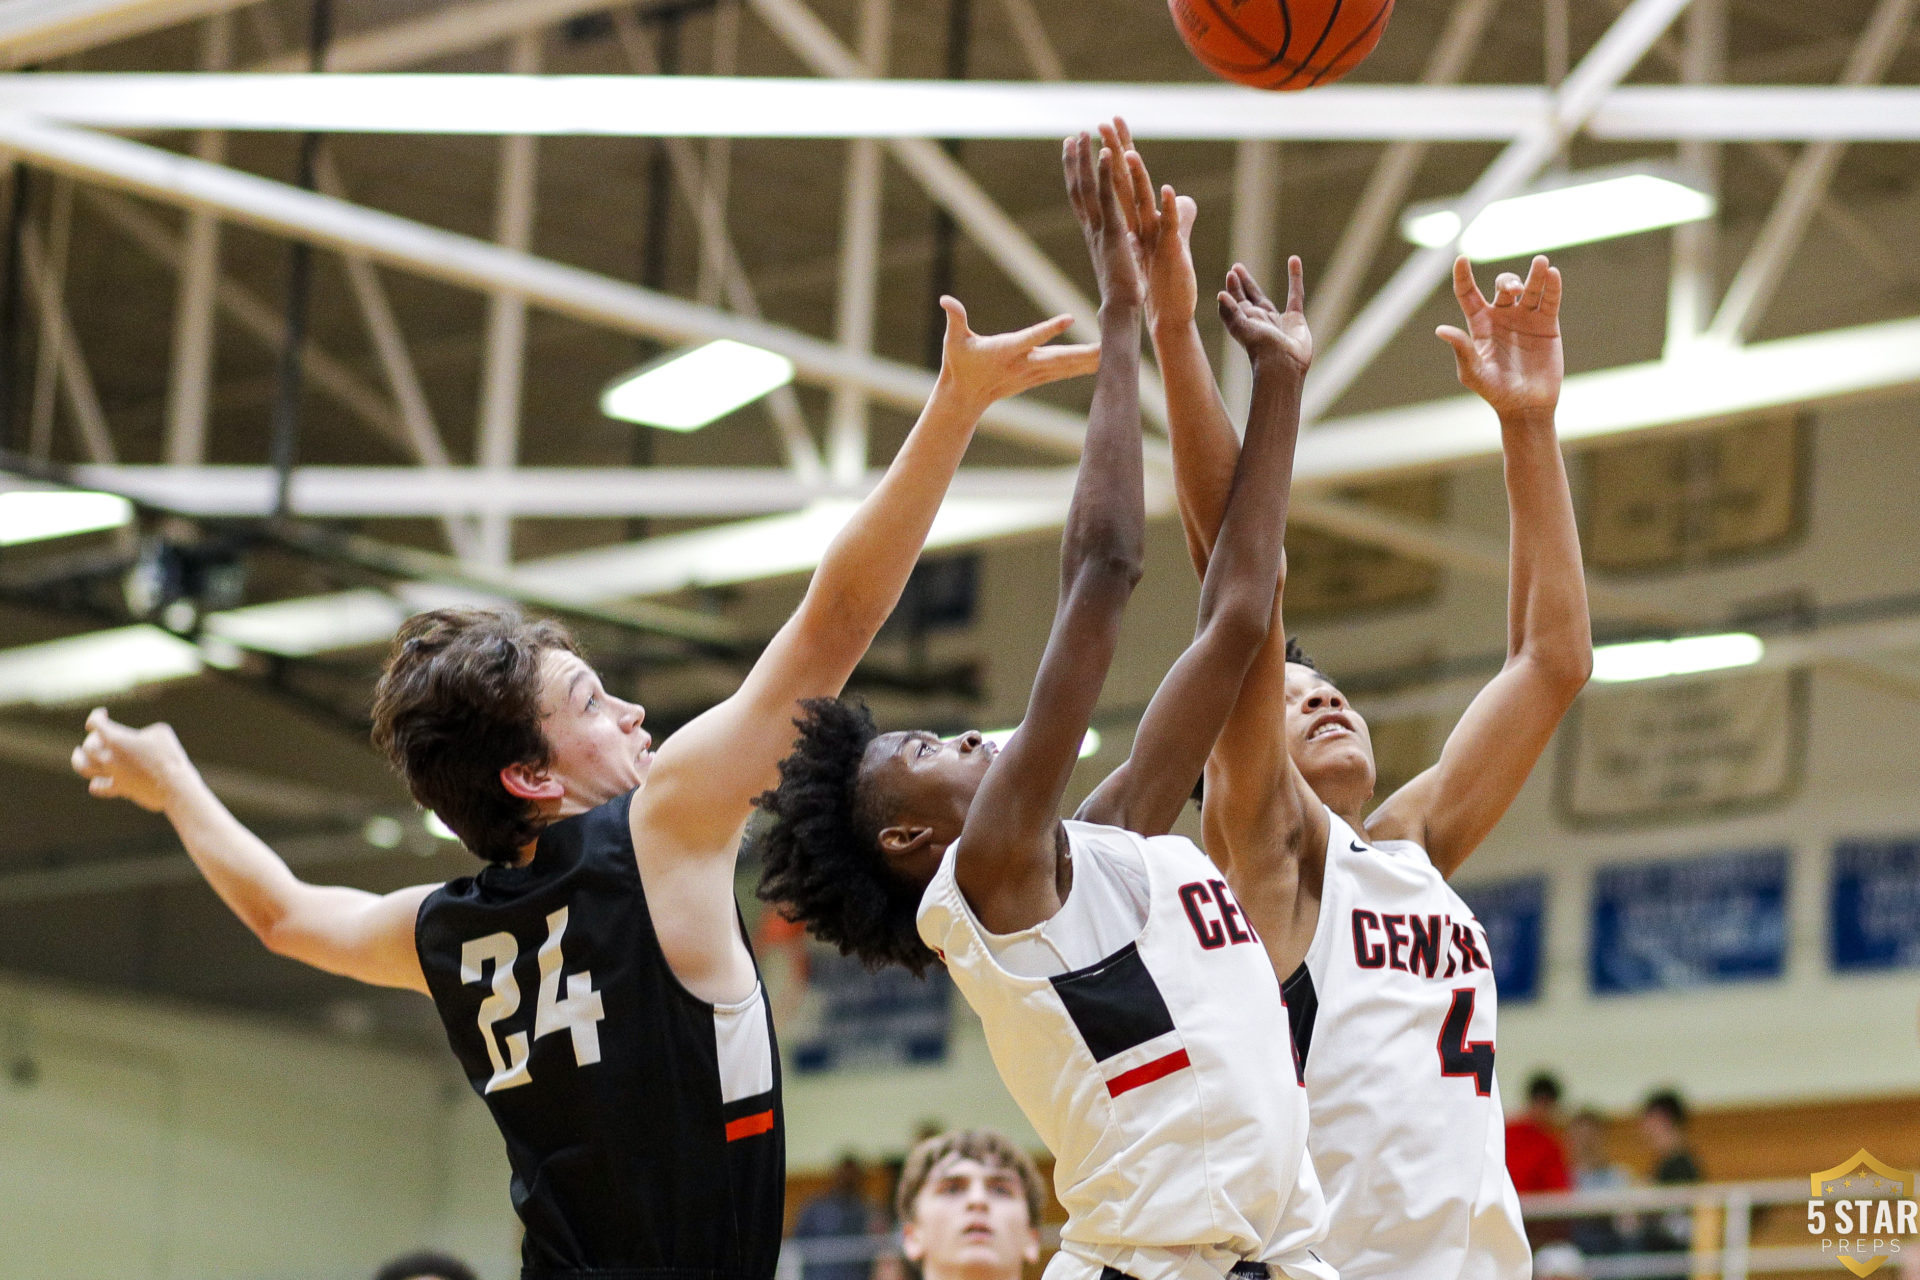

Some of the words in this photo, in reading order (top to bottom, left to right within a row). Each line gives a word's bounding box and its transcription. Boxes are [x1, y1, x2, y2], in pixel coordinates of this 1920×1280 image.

[1178, 879, 1259, 950] CE
[460, 905, 605, 1095] 24
[1437, 987, 1496, 1097] 4
